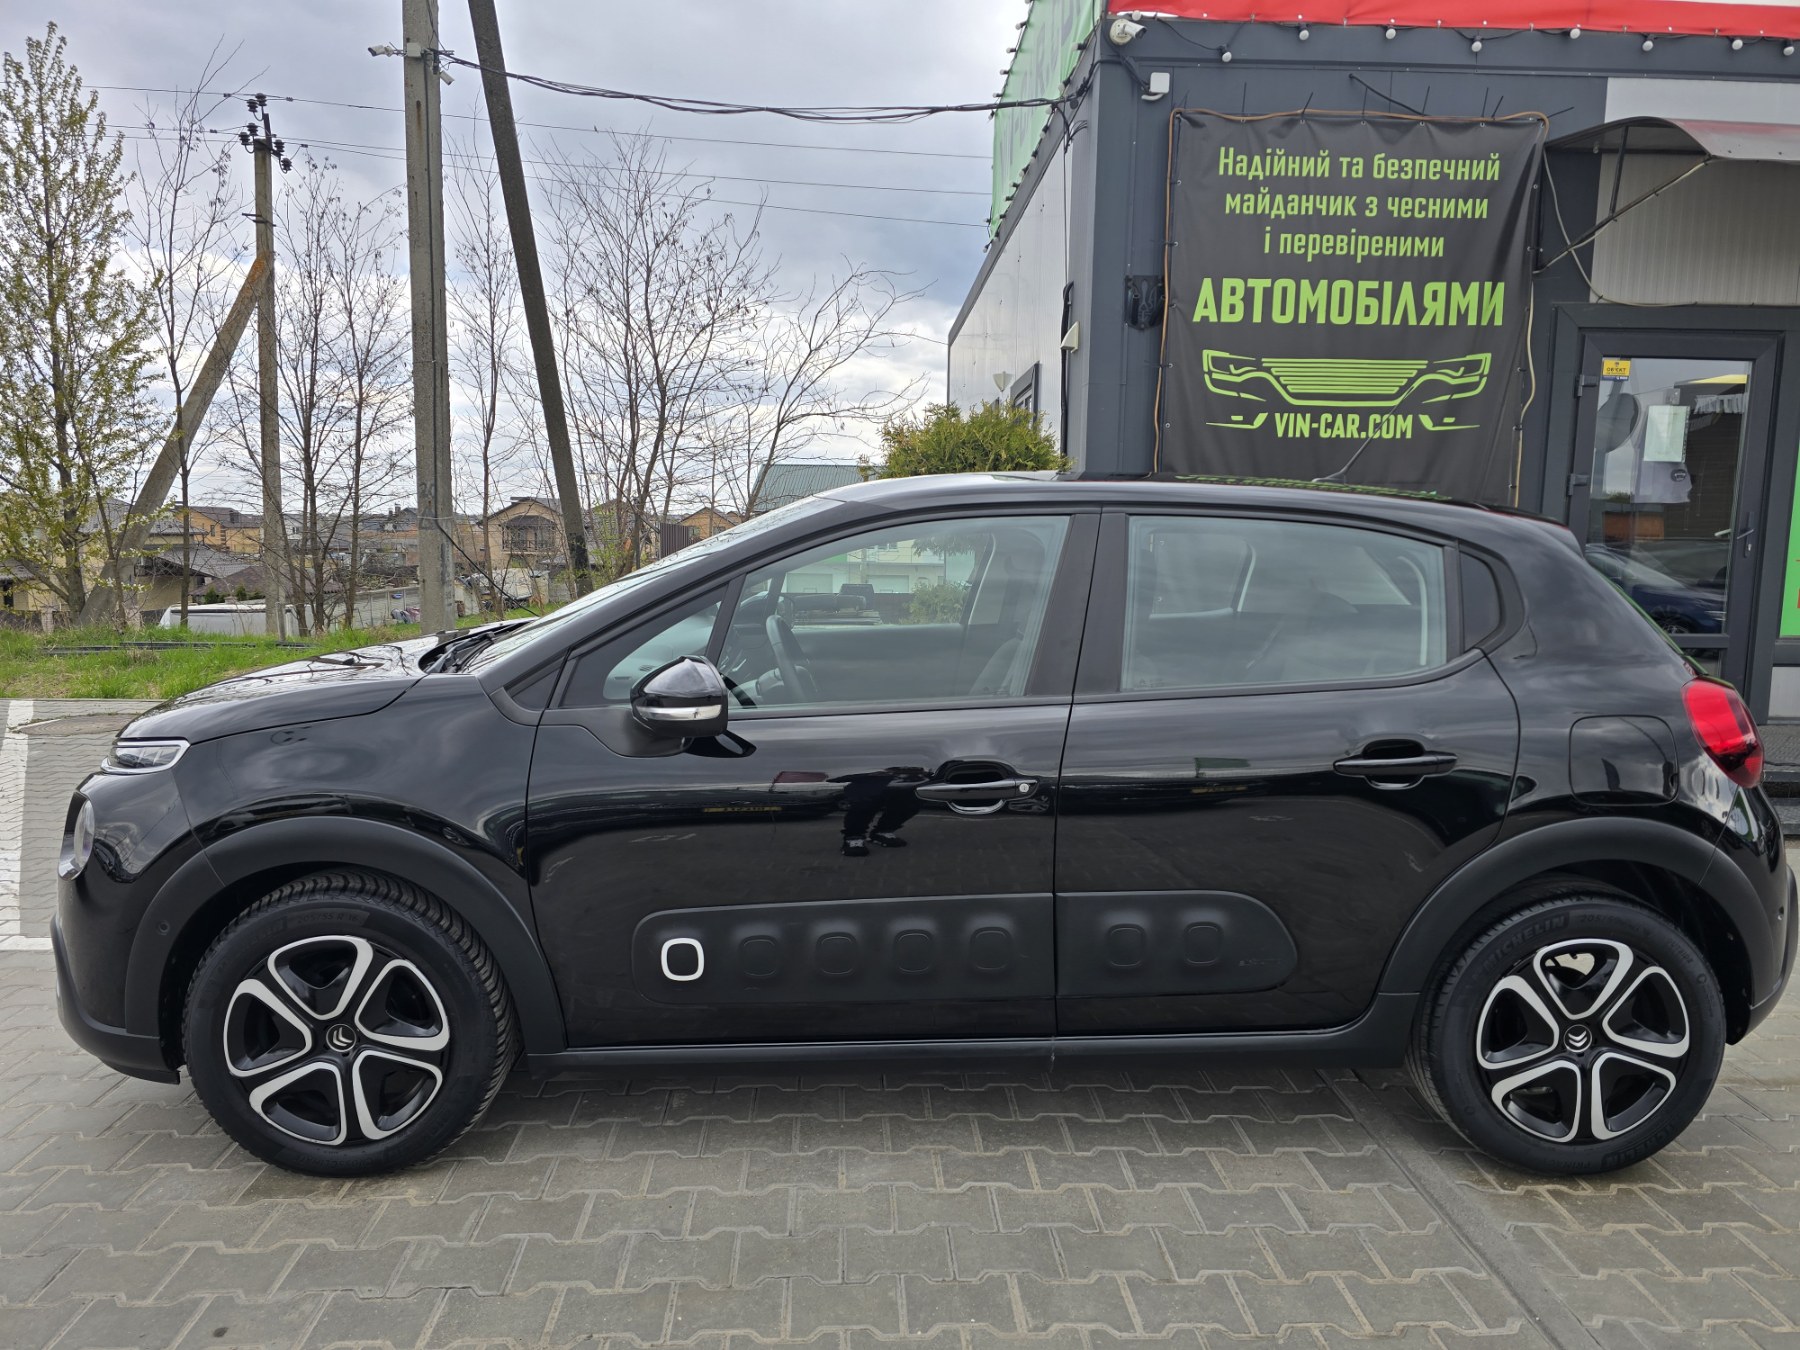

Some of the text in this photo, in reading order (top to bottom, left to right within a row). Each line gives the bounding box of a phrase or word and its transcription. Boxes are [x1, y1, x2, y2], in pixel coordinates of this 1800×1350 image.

[1219, 147, 1500, 181] Надійний та безпечний
[1225, 187, 1489, 219] майданчик з чесними
[1263, 227, 1445, 263] і перевіреними
[1192, 277, 1505, 326] АВТОМОБІЛЯМИ
[1274, 412, 1413, 439] VIN-CAR.COM
[1480, 915, 1566, 972] MICHELIN
